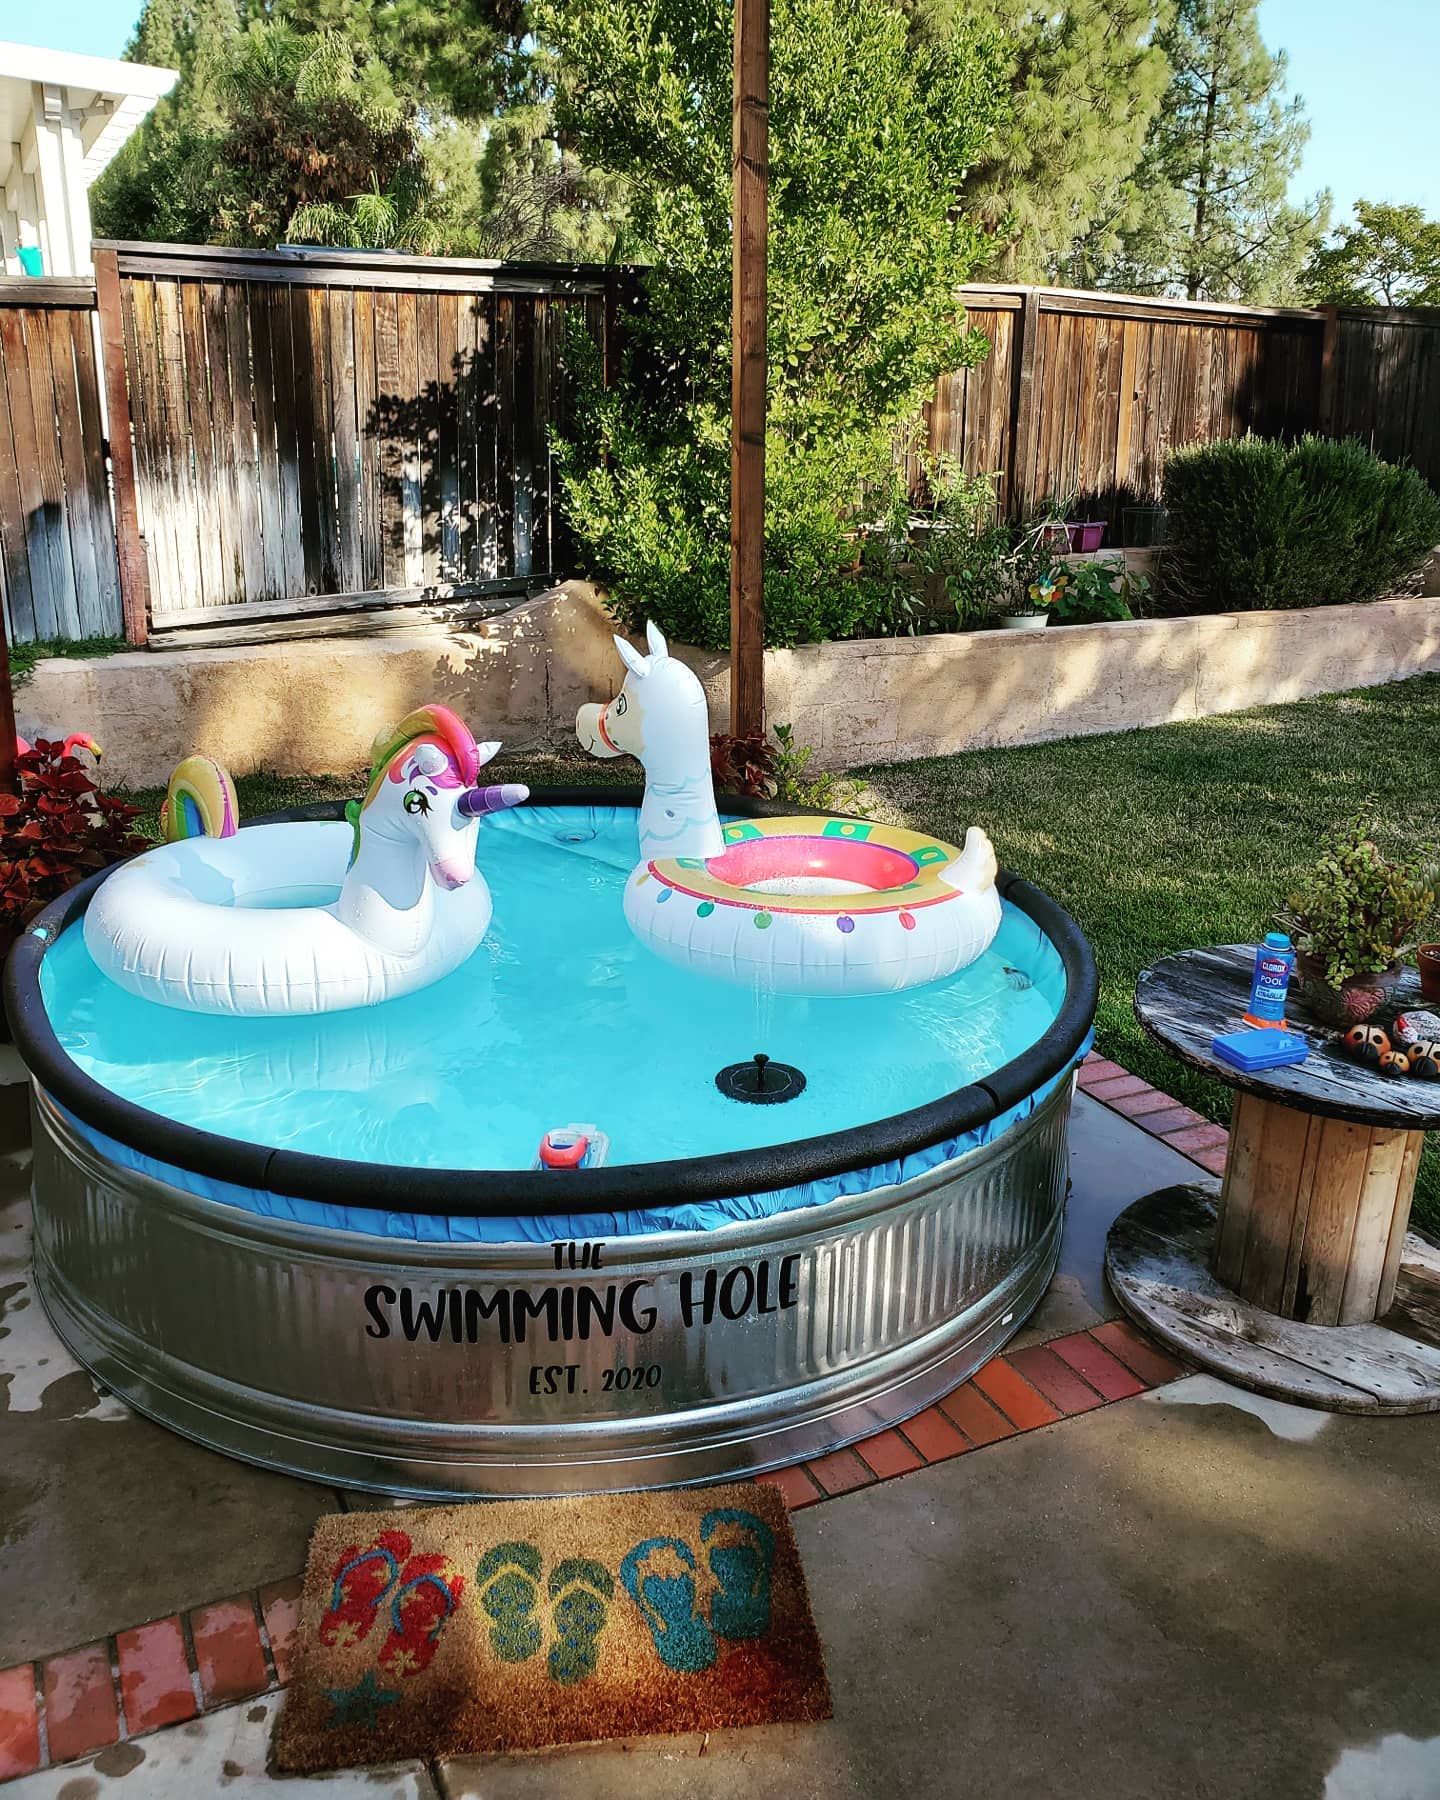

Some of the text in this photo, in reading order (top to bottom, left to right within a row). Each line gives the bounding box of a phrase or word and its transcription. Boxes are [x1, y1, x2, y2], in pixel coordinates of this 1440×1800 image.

[1260, 975, 1282, 985] POOL
[1262, 962, 1286, 972] CLOROX
[551, 1242, 606, 1271] THE
[365, 1253, 801, 1344] SWIMMING HOLE
[529, 1364, 662, 1395] EST. 2020
